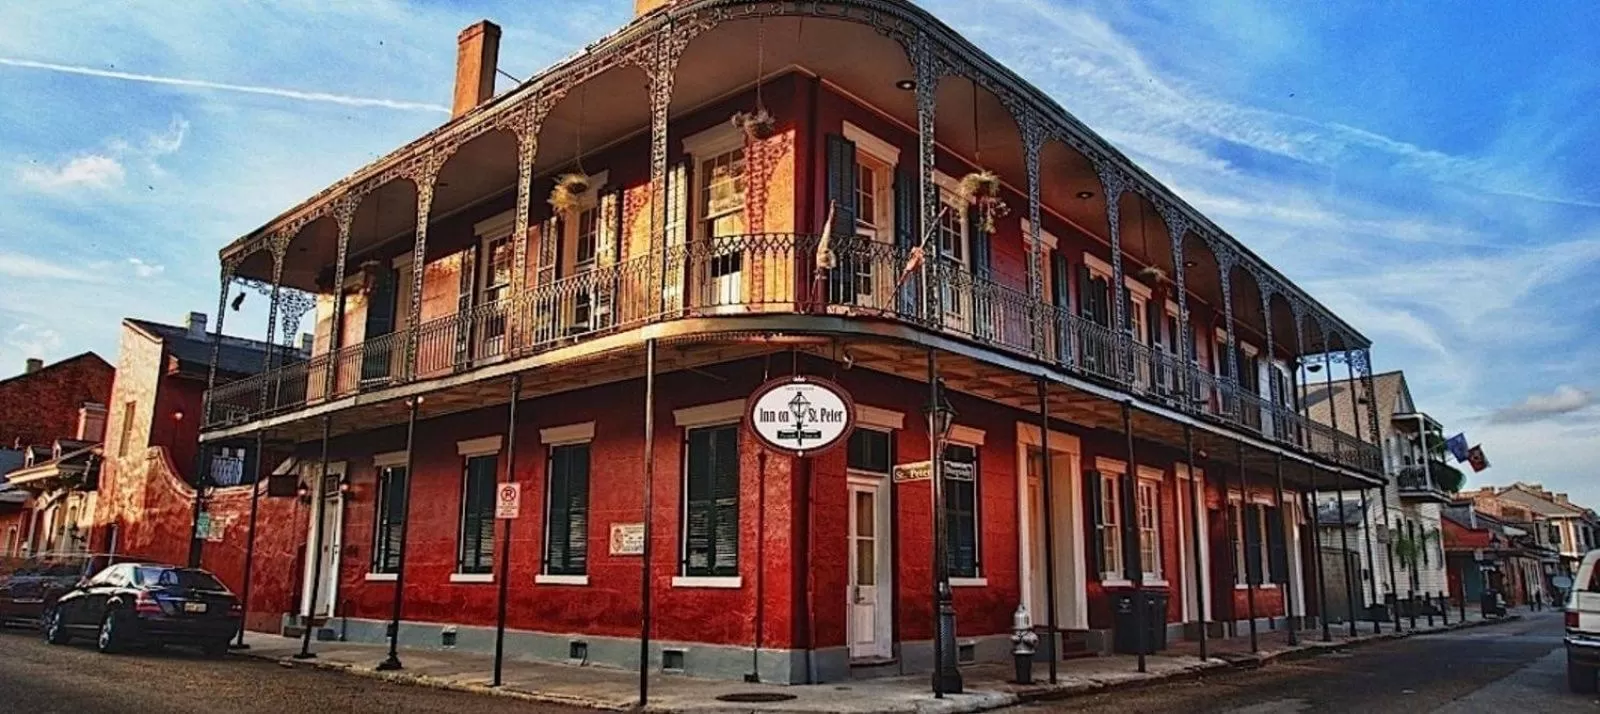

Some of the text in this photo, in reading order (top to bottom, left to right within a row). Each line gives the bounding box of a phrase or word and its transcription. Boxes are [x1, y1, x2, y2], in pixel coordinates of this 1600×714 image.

[760, 408, 843, 422] Inn on St. Peter
[910, 469, 930, 478] Peter
